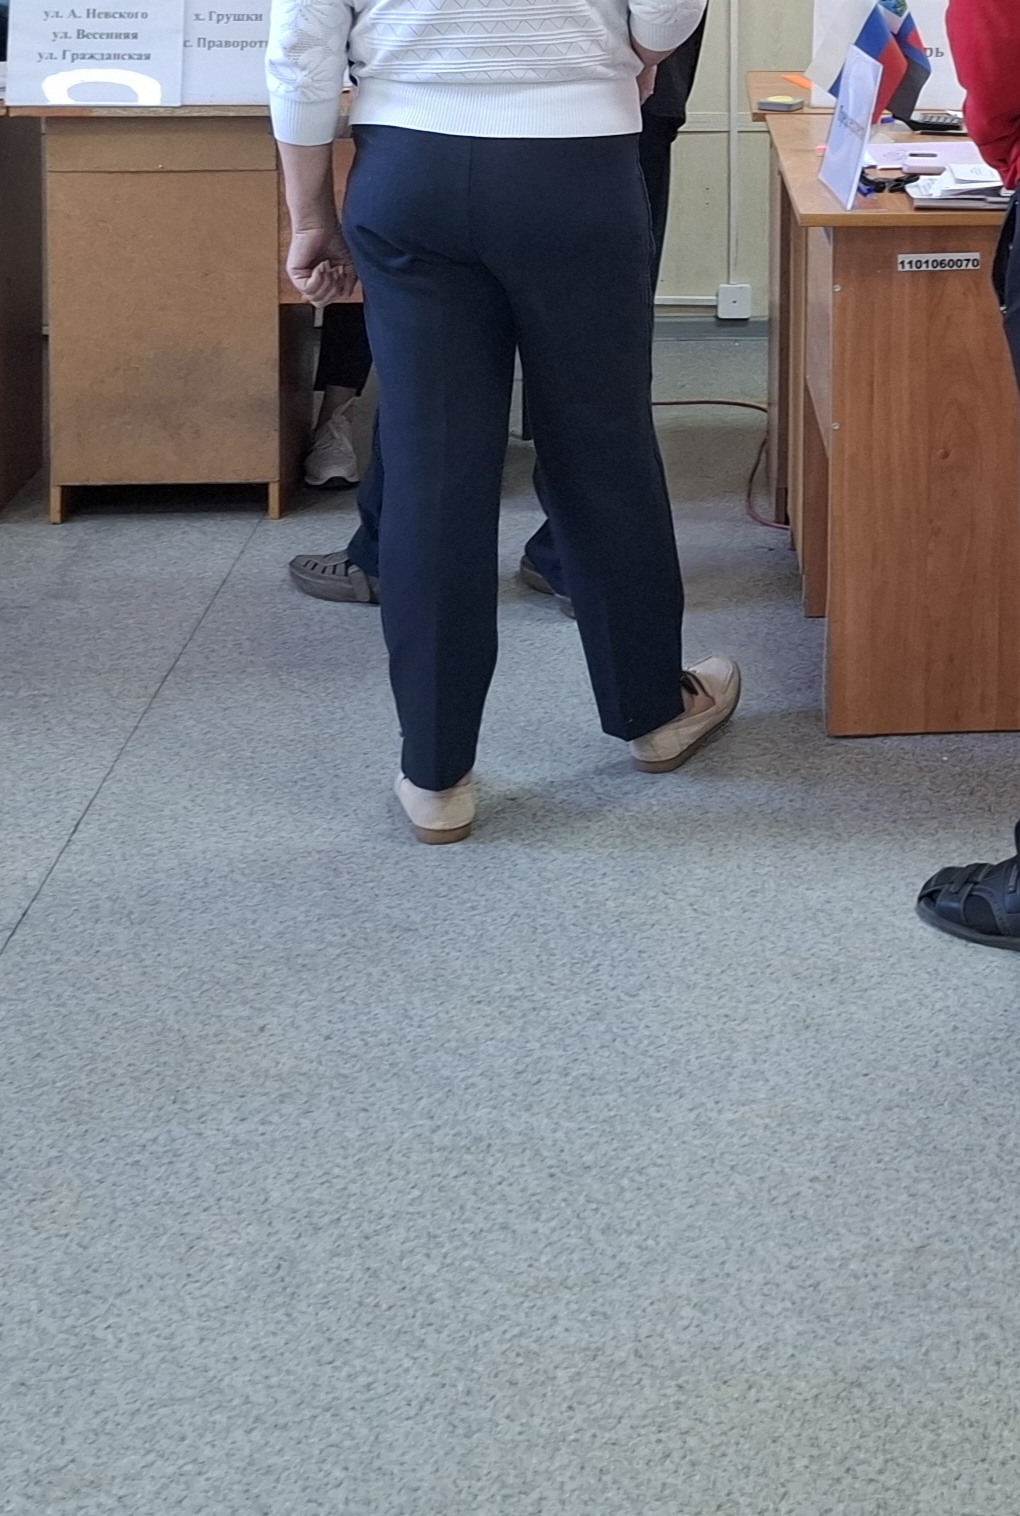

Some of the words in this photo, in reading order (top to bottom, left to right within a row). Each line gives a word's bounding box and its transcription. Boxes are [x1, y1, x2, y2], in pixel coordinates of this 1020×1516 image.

[43, 9, 63, 21] ул.
[67, 8, 81, 20] А.
[86, 8, 149, 20] Невского
[208, 11, 263, 25] Грушки
[52, 31, 72, 41] ул.
[76, 28, 139, 40] Весенняя
[37, 51, 58, 62] ул.
[62, 49, 151, 63] Гражданская
[899, 258, 980, 270] 1101060070
